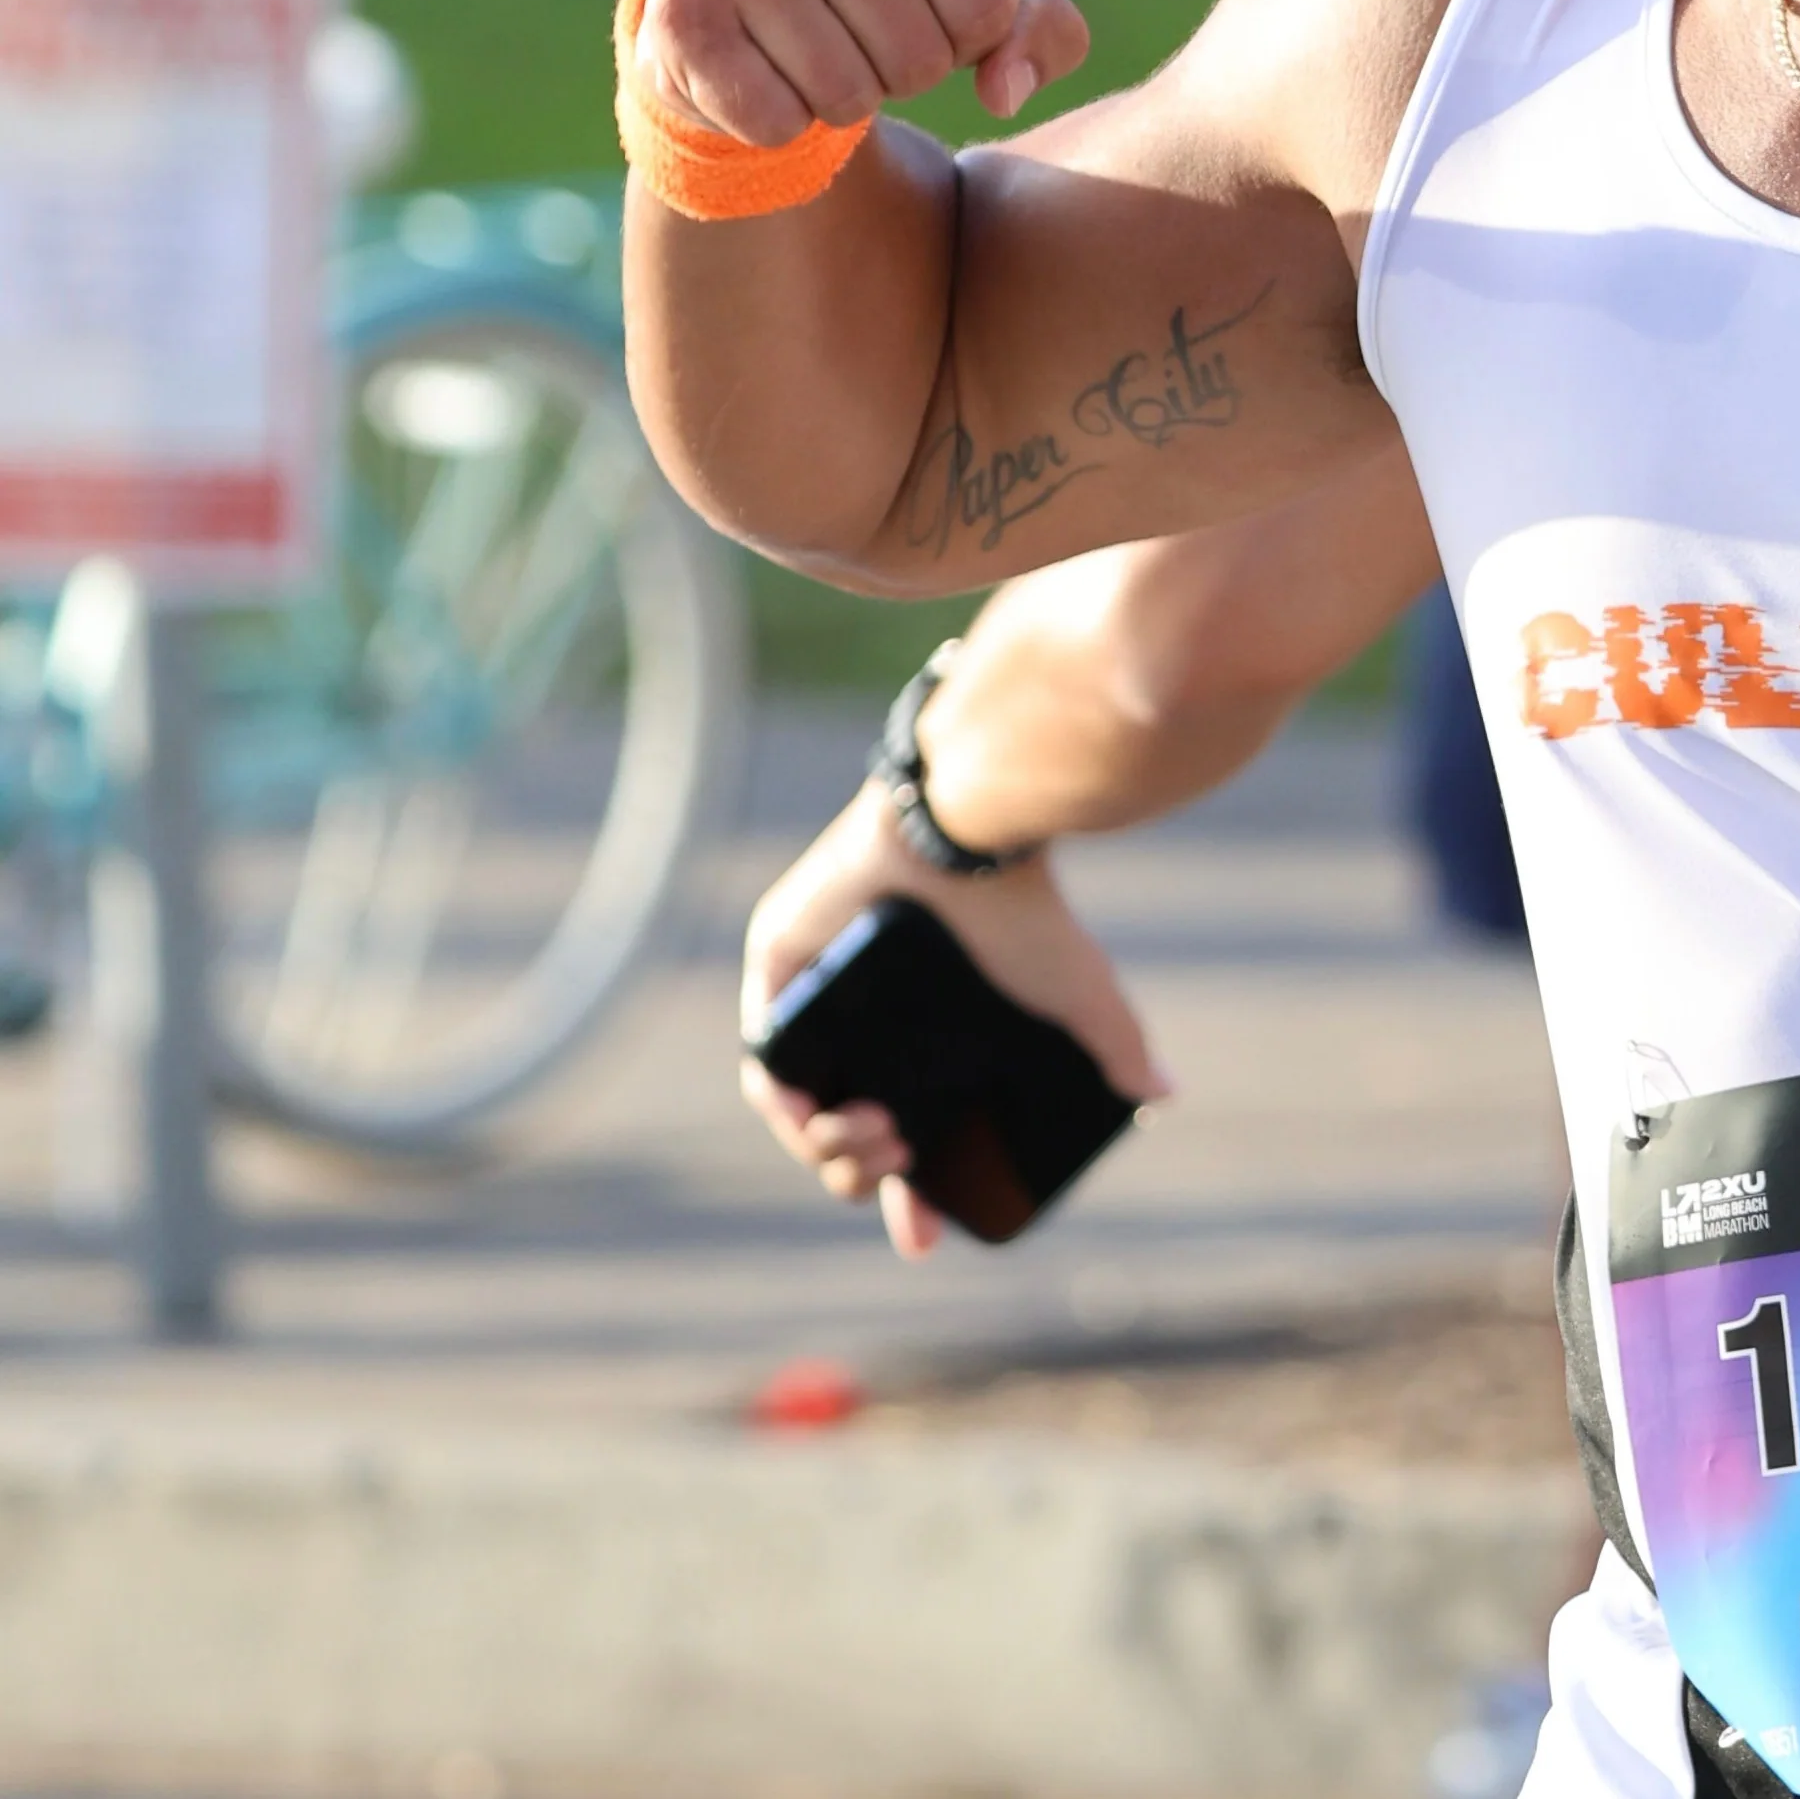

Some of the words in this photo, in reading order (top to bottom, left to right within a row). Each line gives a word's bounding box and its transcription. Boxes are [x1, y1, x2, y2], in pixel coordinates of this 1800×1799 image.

[907, 421, 1102, 561] Paper
[1073, 278, 1276, 447] City
[1701, 1170, 1766, 1202] 2XU
[1703, 1203, 1731, 1221] LONG
[1731, 1196, 1768, 1216] BEACH
[1703, 1213, 1770, 1240] MARATHON
